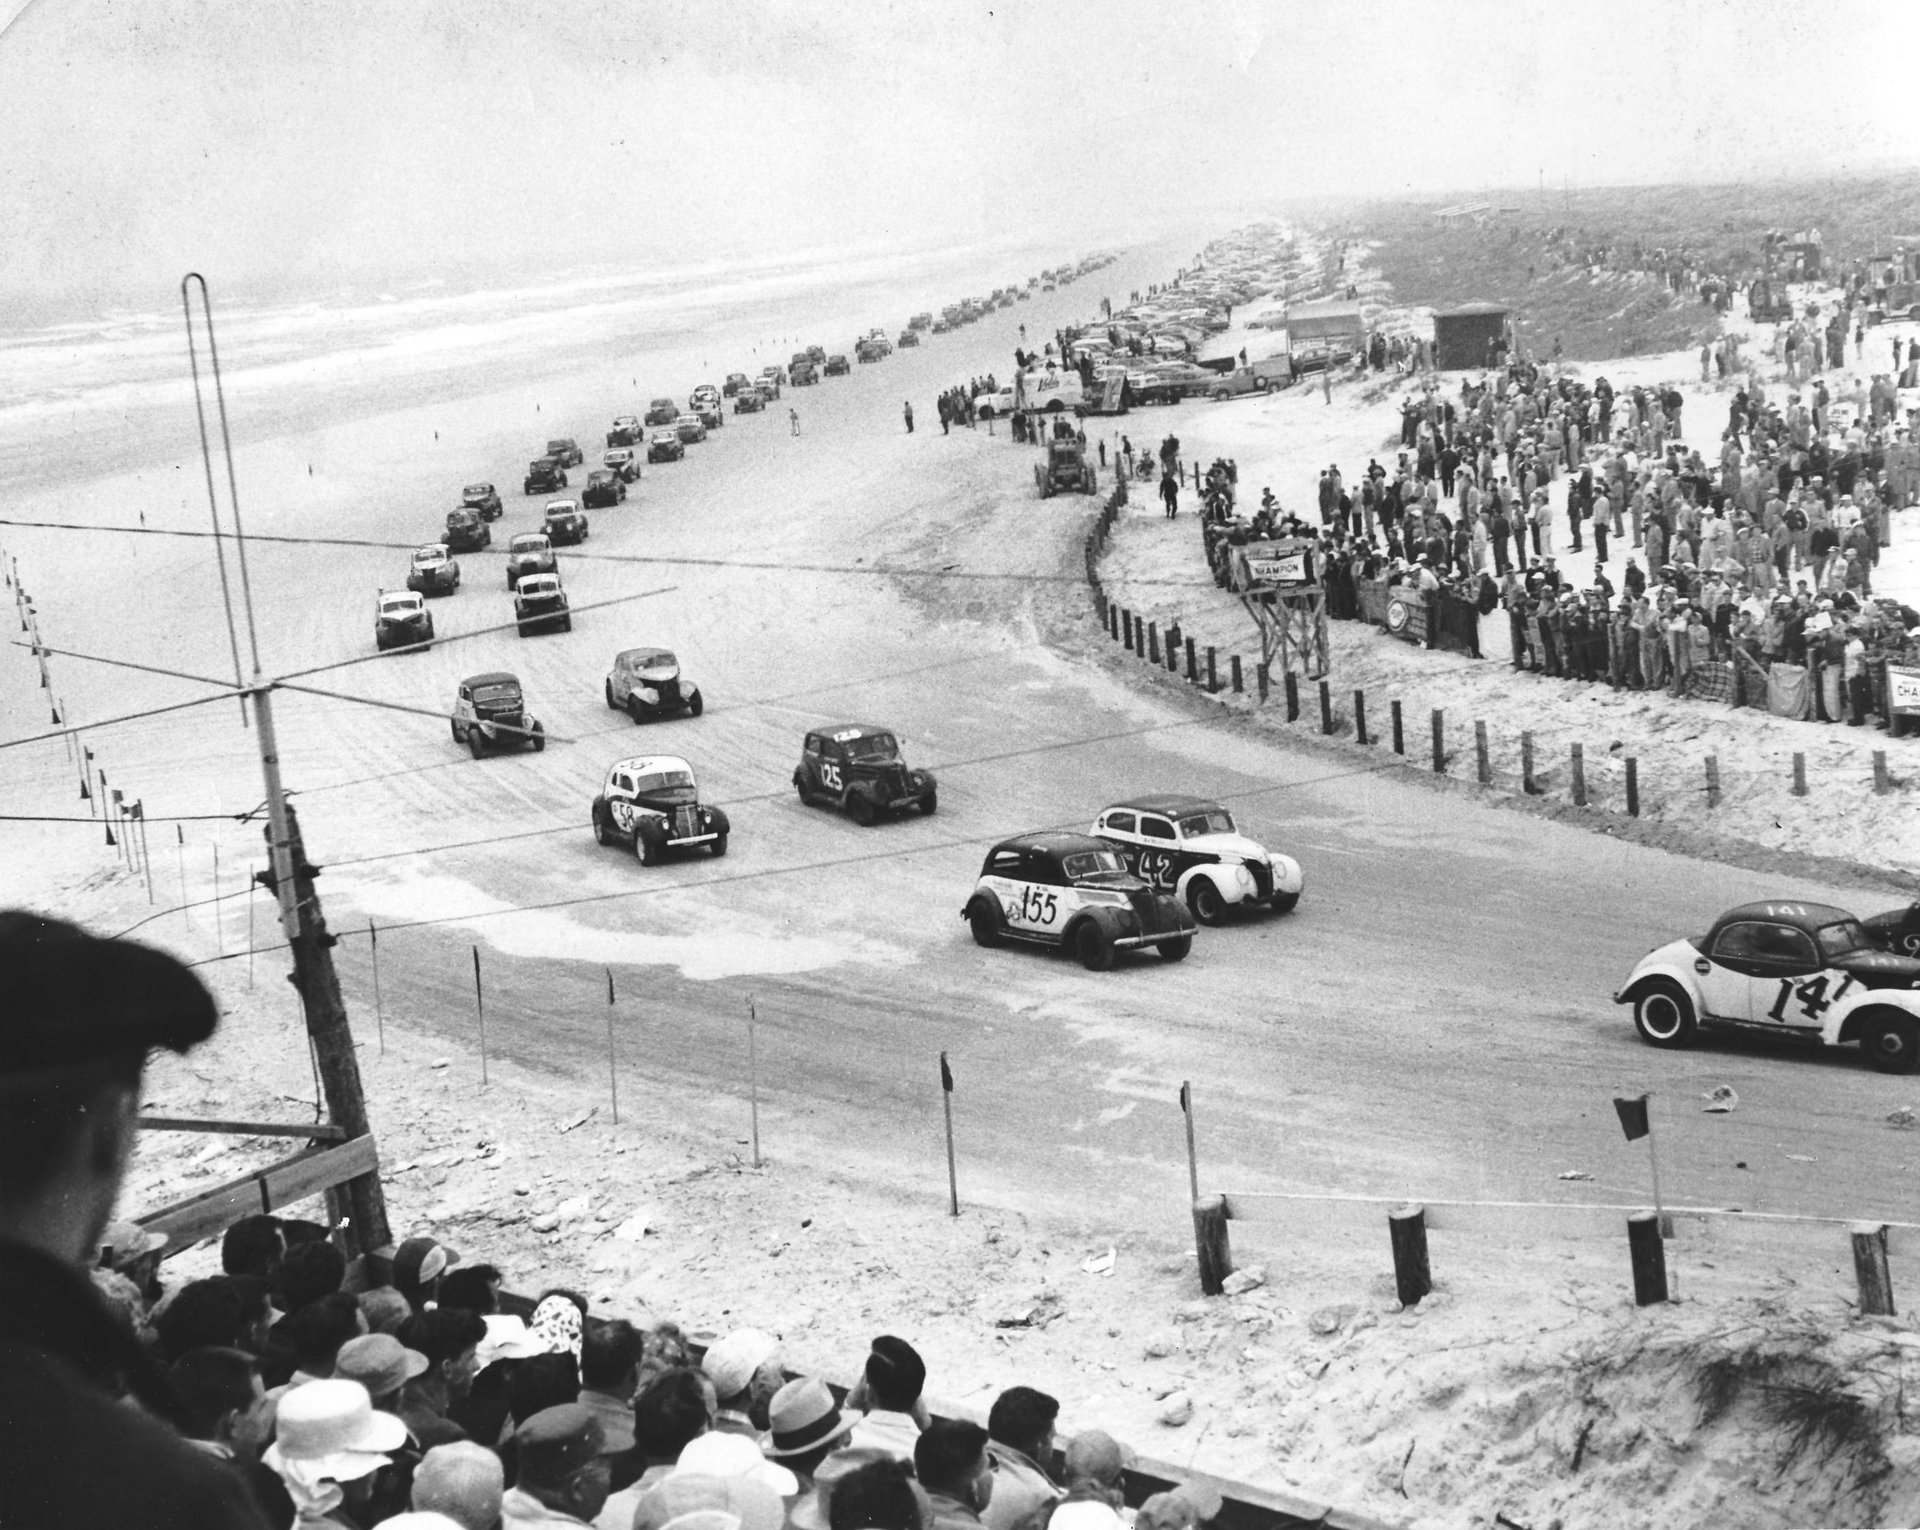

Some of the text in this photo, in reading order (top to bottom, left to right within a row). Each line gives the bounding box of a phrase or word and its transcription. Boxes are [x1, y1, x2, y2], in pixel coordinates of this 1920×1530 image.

[820, 763, 843, 791] 125
[1139, 851, 1175, 889] 42
[1022, 885, 1058, 925] 155
[1767, 905, 1806, 916] 141
[1768, 975, 1853, 1023] 141
